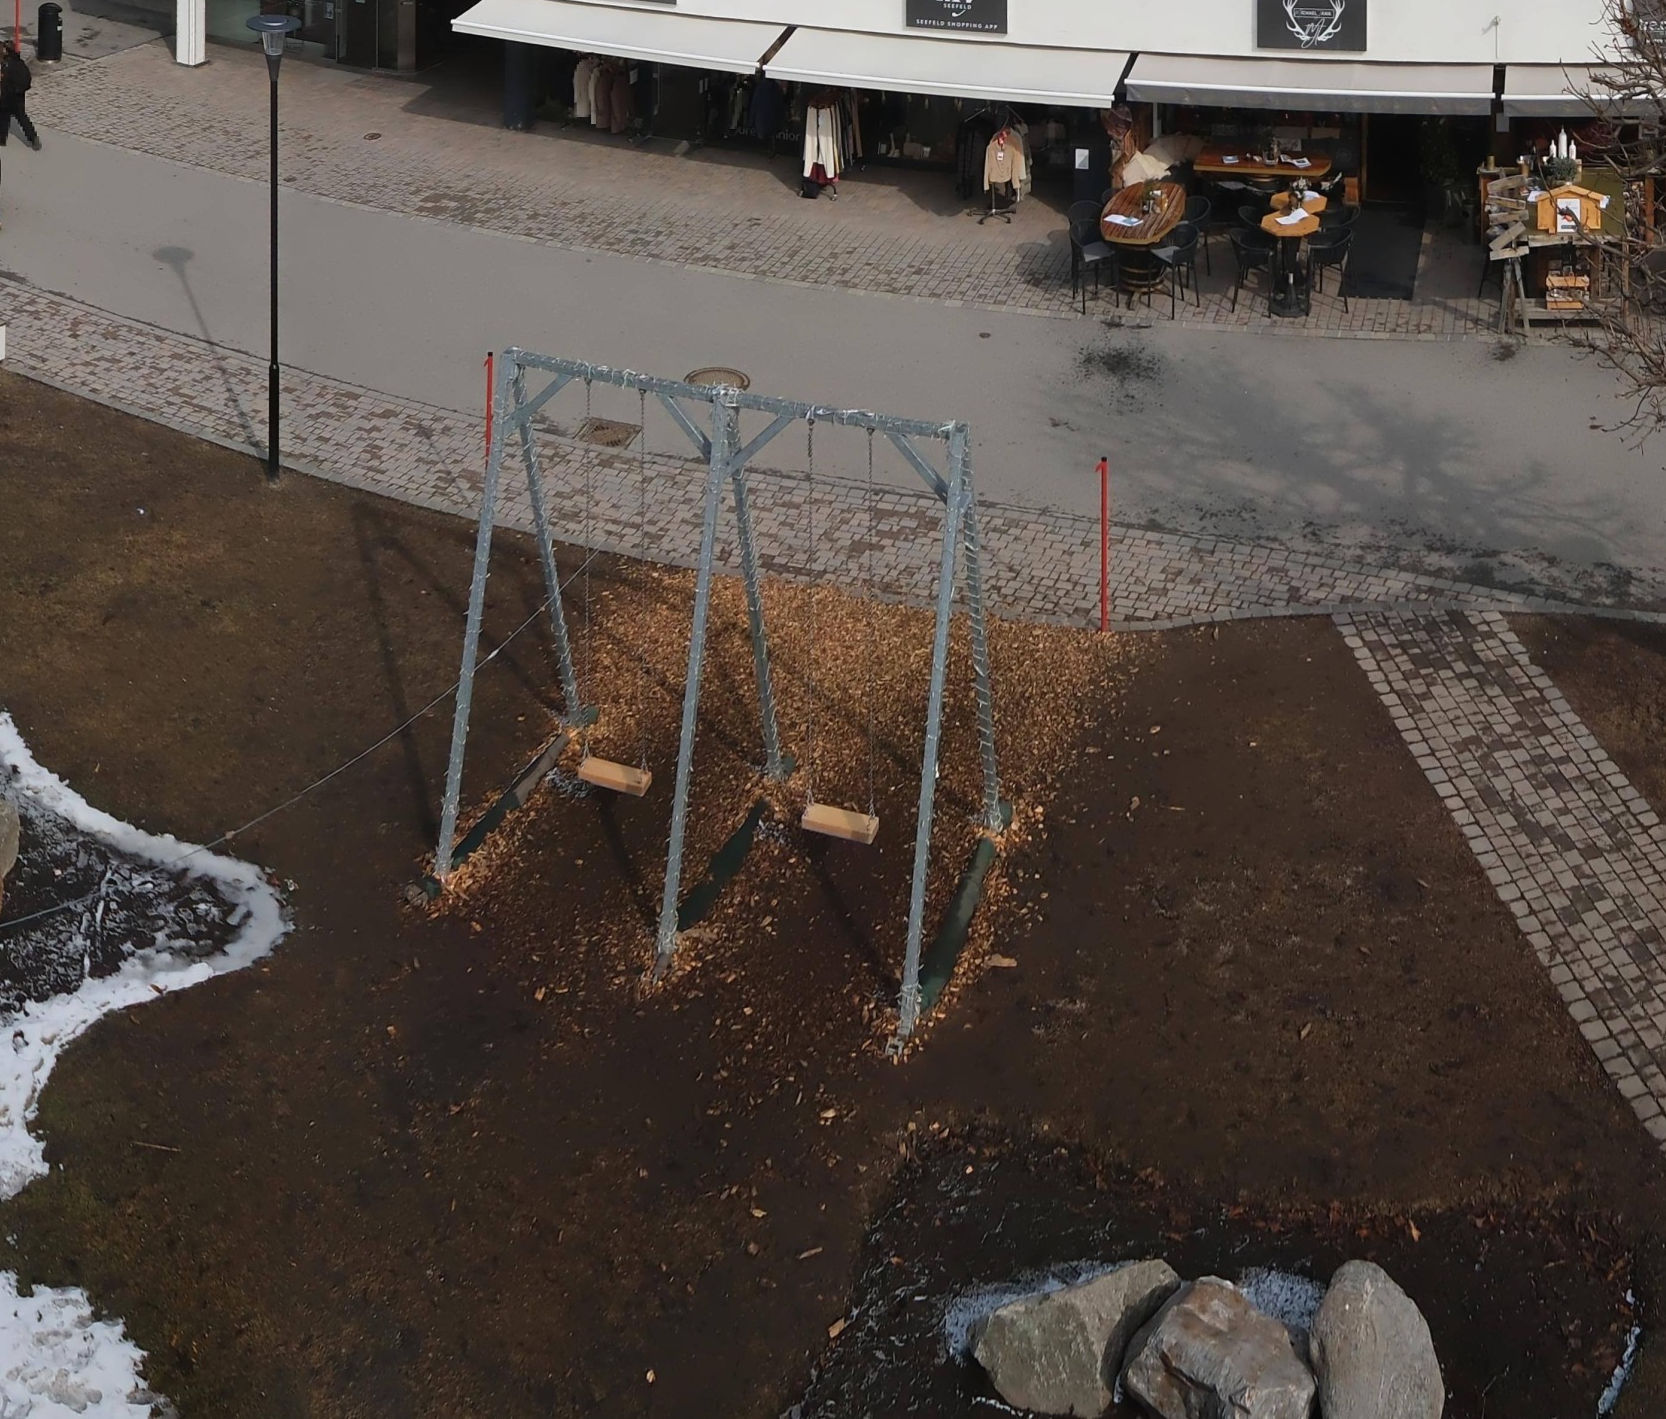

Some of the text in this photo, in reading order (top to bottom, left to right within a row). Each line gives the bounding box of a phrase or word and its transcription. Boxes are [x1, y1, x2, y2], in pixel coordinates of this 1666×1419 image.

[943, 2, 972, 10] SEEFELD
[916, 18, 945, 26] SEEFELD
[947, 21, 983, 29] SHOPPING
